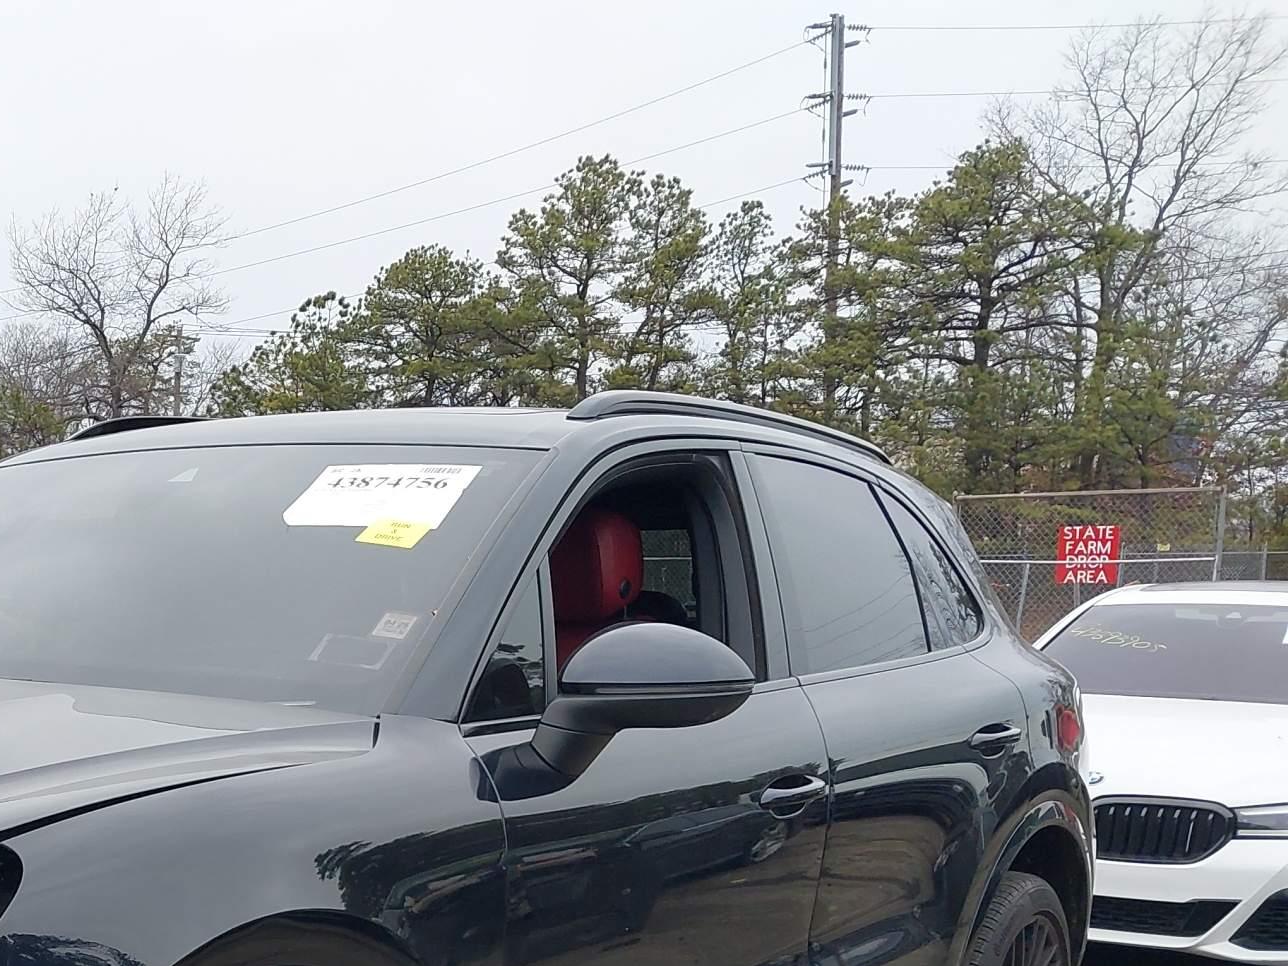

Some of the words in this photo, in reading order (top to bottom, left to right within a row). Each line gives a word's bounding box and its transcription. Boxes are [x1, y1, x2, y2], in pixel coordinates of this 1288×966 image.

[328, 476, 450, 490] 43874756
[1063, 525, 1115, 540] STATE
[1065, 540, 1112, 554] FARM
[1065, 555, 1109, 569] DROP
[1063, 570, 1108, 584] AREA
